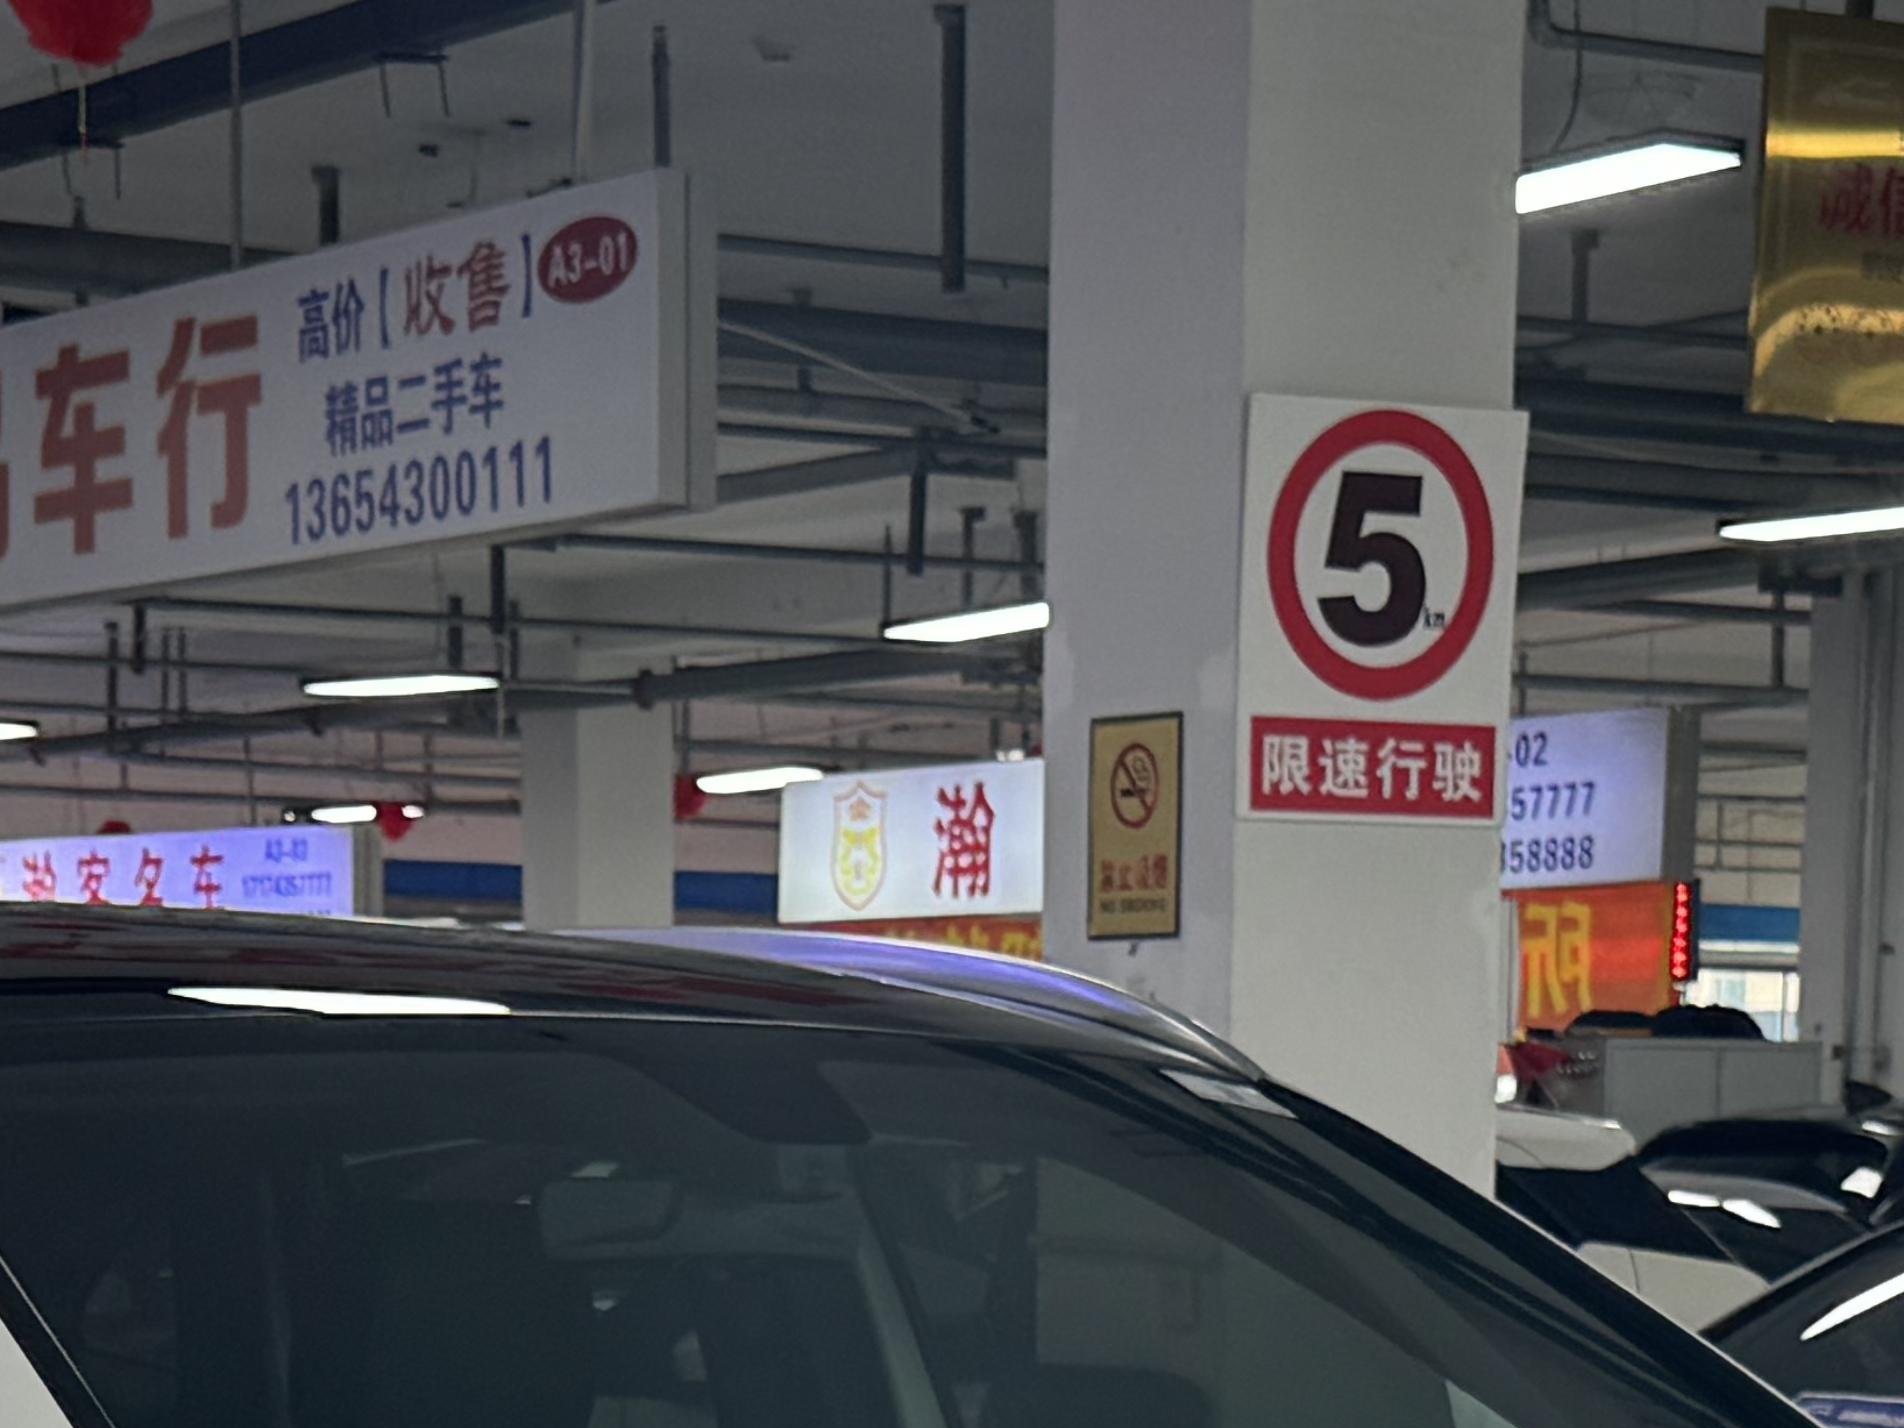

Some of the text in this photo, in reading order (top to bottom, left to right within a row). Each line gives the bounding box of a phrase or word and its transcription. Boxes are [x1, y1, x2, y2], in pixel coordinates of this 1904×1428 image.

[547, 231, 629, 290] A3-01
[324, 351, 505, 458] 精品二手车
[285, 434, 553, 546] 13654300111
[1317, 470, 1426, 648] 5
[1262, 733, 1483, 802] 限速行驶
[933, 780, 996, 899] 瀚
[1499, 834, 1595, 875] 58888
